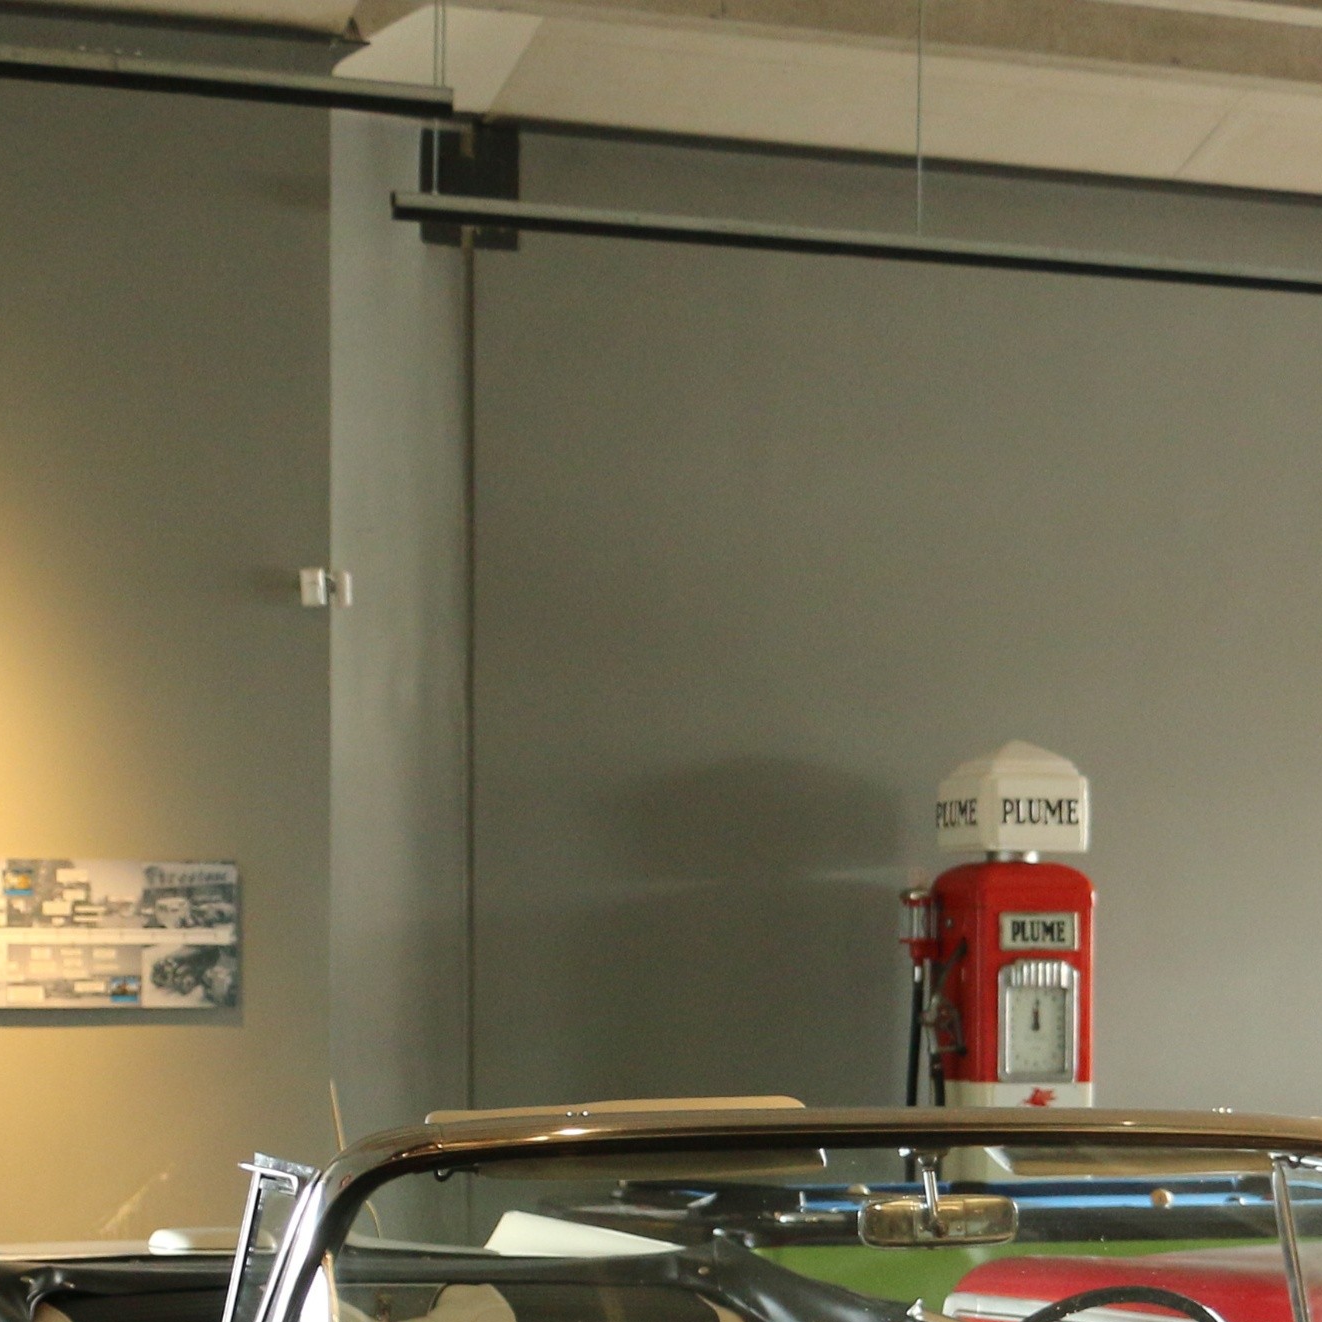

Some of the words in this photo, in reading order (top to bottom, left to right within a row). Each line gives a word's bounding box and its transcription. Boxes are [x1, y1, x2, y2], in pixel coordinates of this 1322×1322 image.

[936, 799, 977, 828] PLUME
[1001, 798, 1079, 826] PLUME
[1010, 920, 1066, 943] PLUME
